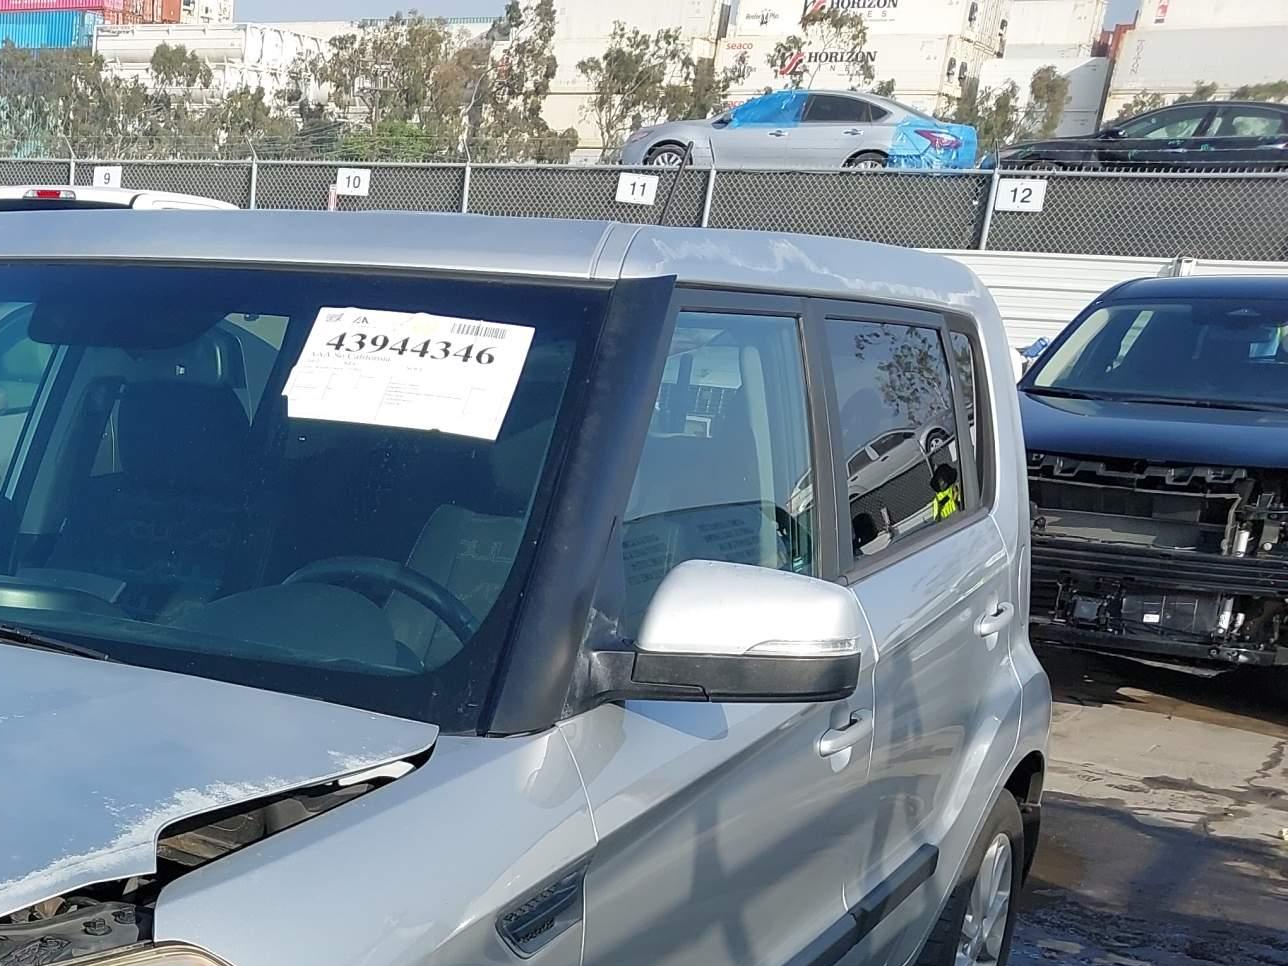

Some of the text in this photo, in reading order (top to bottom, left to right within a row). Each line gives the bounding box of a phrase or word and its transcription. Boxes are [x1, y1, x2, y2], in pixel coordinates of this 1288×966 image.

[726, 42, 753, 50] seaco
[808, 51, 878, 63] HORIZON
[103, 172, 110, 184] 9
[345, 175, 361, 189] 10
[629, 182, 647, 196] 11
[1010, 187, 1033, 204] 12
[325, 331, 497, 365] 43944346
